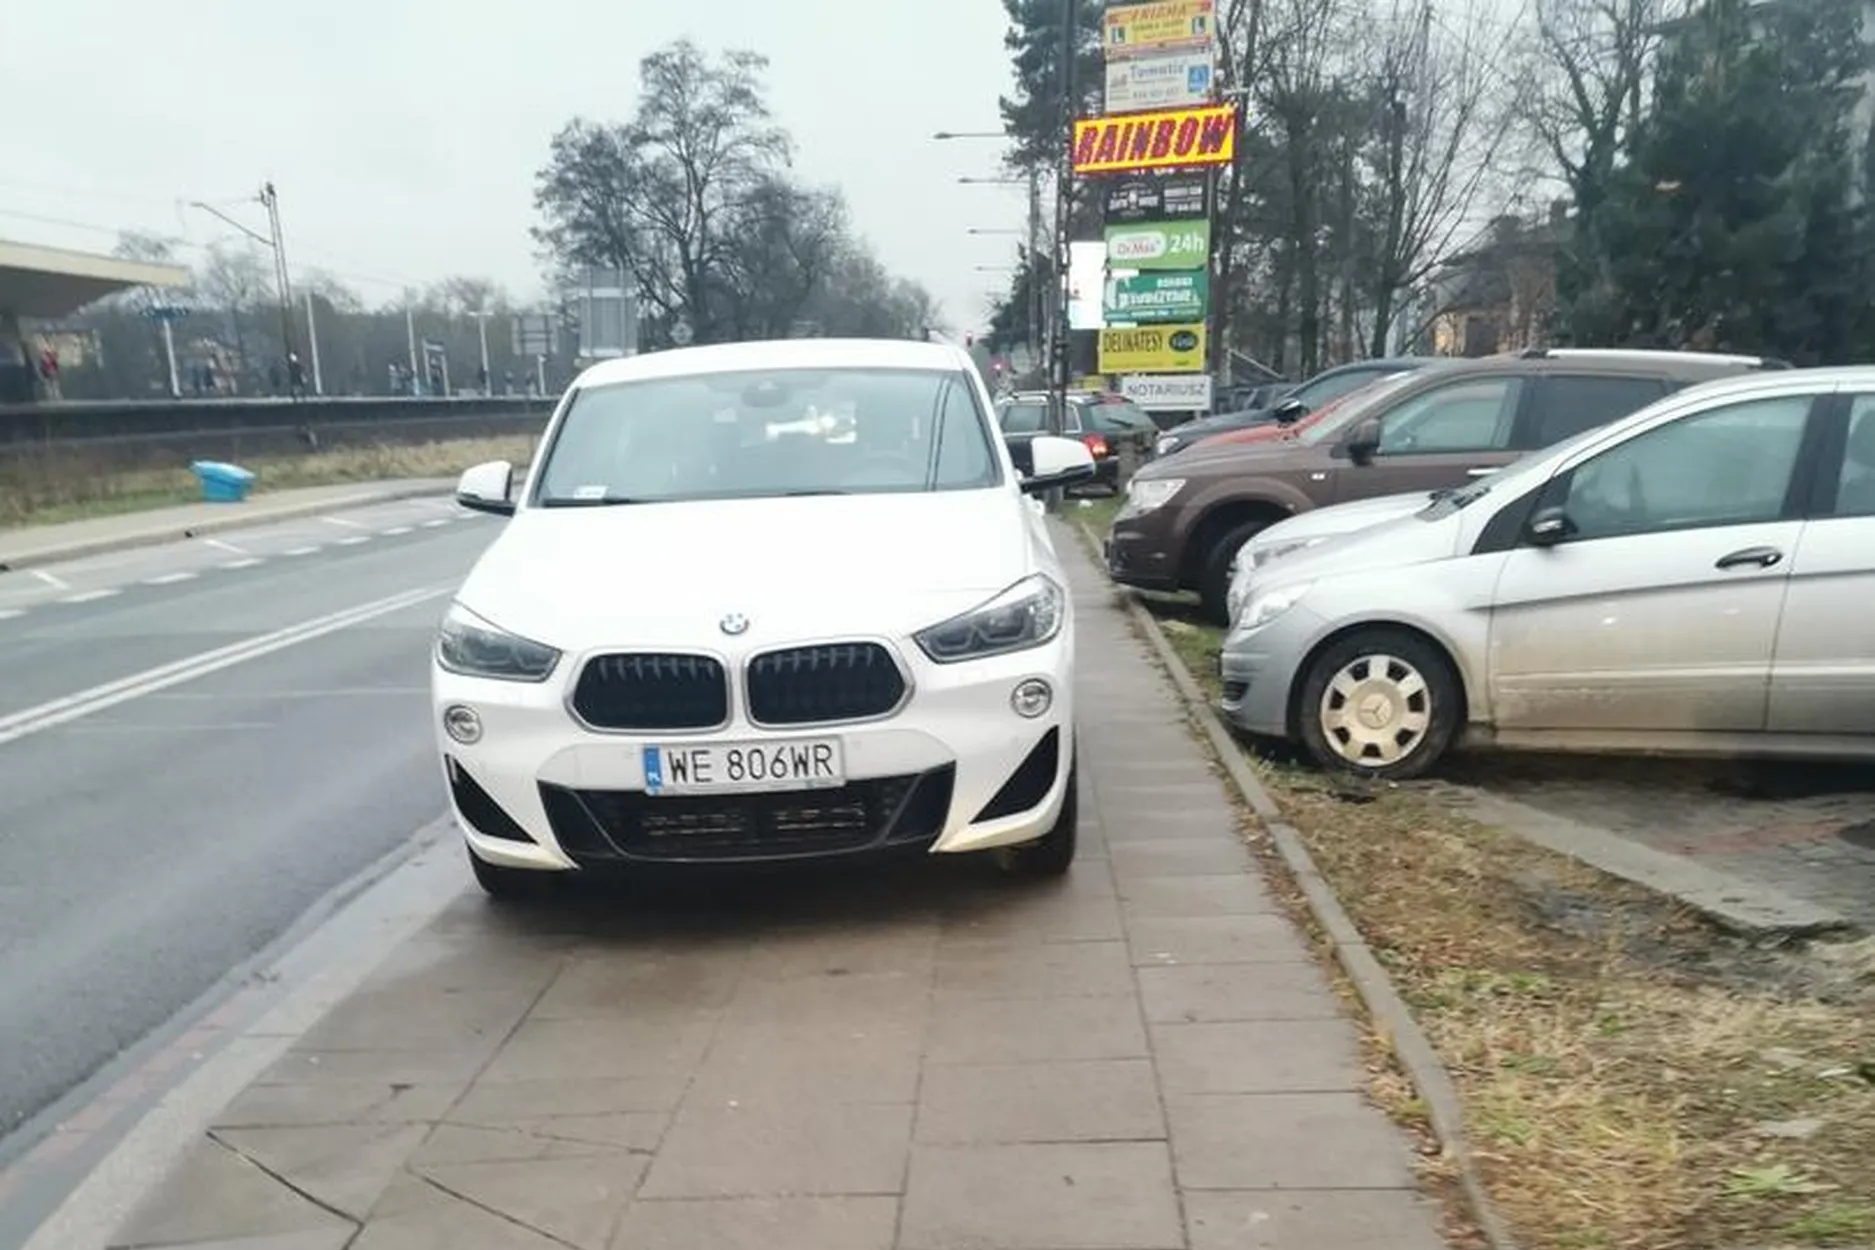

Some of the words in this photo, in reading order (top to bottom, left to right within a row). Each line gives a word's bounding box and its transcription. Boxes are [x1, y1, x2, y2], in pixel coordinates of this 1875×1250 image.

[1074, 116, 1231, 166] RAINBOW
[1169, 232, 1204, 253] 24h
[1103, 330, 1163, 352] DELIKATESY
[1128, 383, 1205, 396] NOTARIUSZ
[668, 750, 712, 783] WE
[727, 744, 833, 780] 806WR
